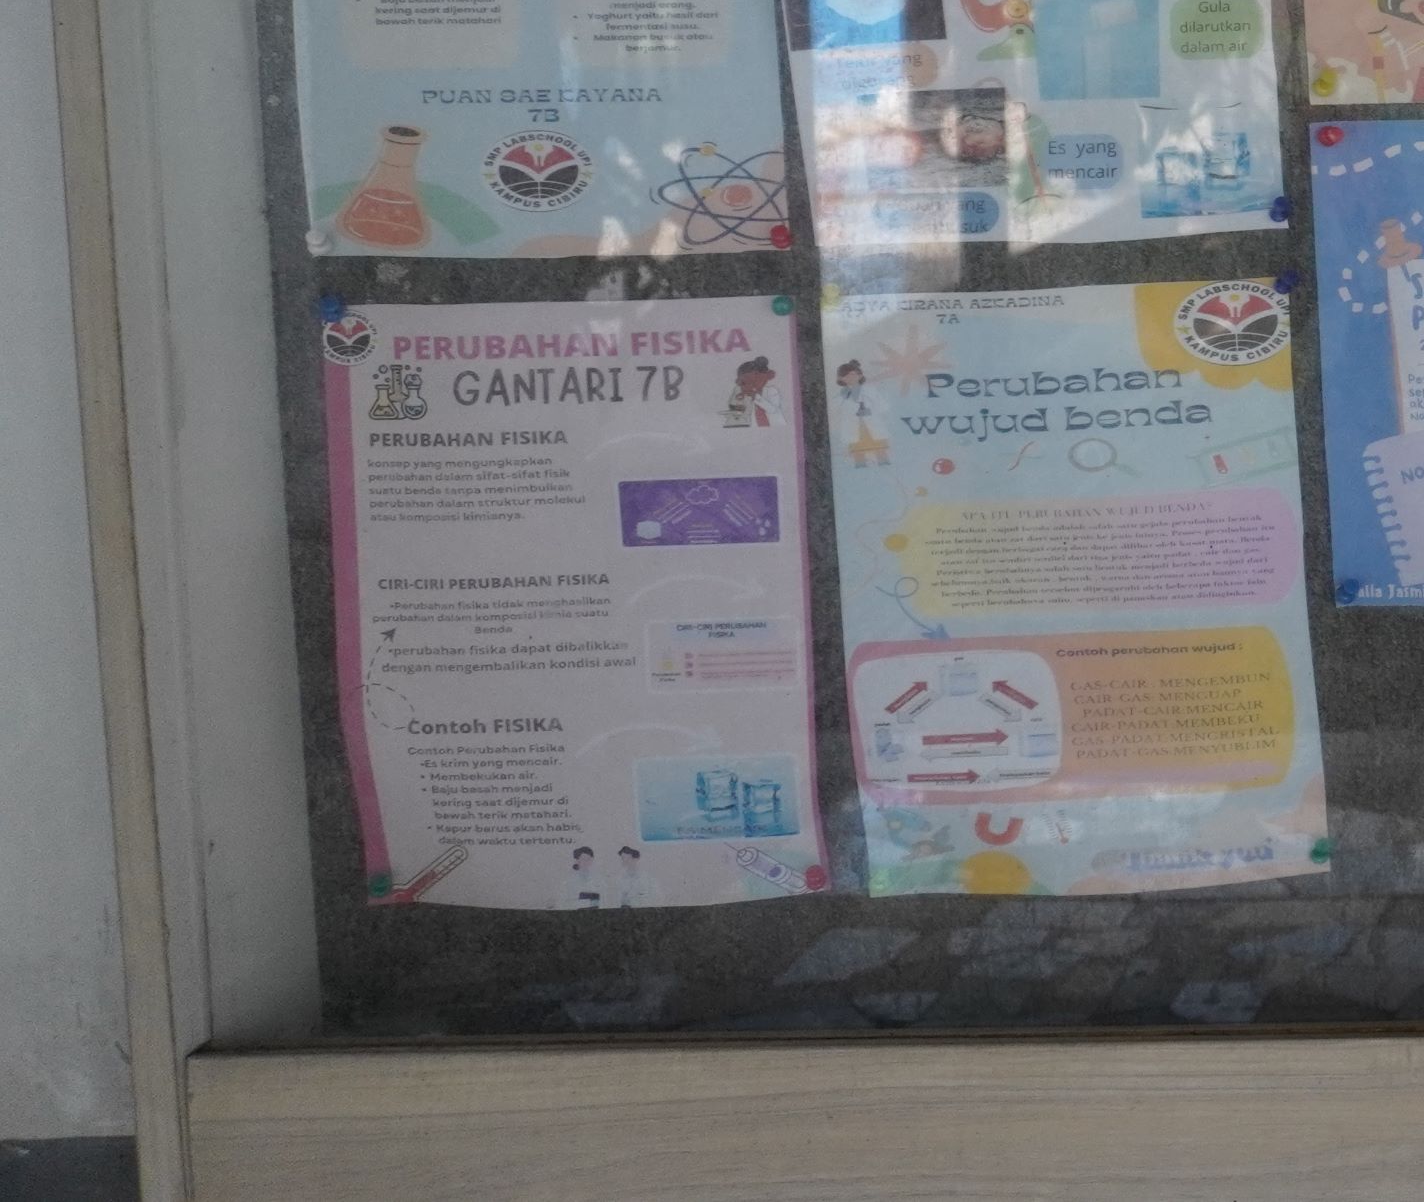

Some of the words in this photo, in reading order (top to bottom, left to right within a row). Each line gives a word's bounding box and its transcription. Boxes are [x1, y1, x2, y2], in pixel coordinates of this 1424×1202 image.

[1178, 18, 1252, 35] dilarutkan
[421, 89, 493, 105] PUAN
[557, 87, 663, 104] KAYANA
[527, 108, 561, 124] 7B
[1047, 141, 1067, 156] Es
[1074, 141, 1118, 160] yang
[1047, 164, 1119, 180] mencair
[489, 180, 543, 209] KAMPUS
[546, 180, 590, 208] CIBIRU
[1177, 299, 1197, 322] SMP
[1195, 282, 1276, 304] LABSCHOOL
[392, 332, 621, 362] PERUBAHAN
[630, 328, 752, 357] FISIKA
[1182, 335, 1240, 363] KAMPUS
[1245, 330, 1289, 363] CIBIRU
[452, 367, 625, 407] GANTARI
[638, 365, 685, 403] 7B
[926, 369, 1183, 399] Perubahan
[899, 407, 1051, 442] wujud
[1064, 399, 1214, 433] benda
[368, 431, 494, 448] PERUBAHAN
[500, 429, 569, 445] FISIKA
[377, 576, 445, 591] CIRI-CIRI
[448, 574, 553, 590] PERUBAHAN
[555, 573, 611, 586] FISIKA
[1192, 642, 1236, 653] wujud
[406, 718, 487, 735] Contoh
[492, 717, 564, 734] FISIKA
